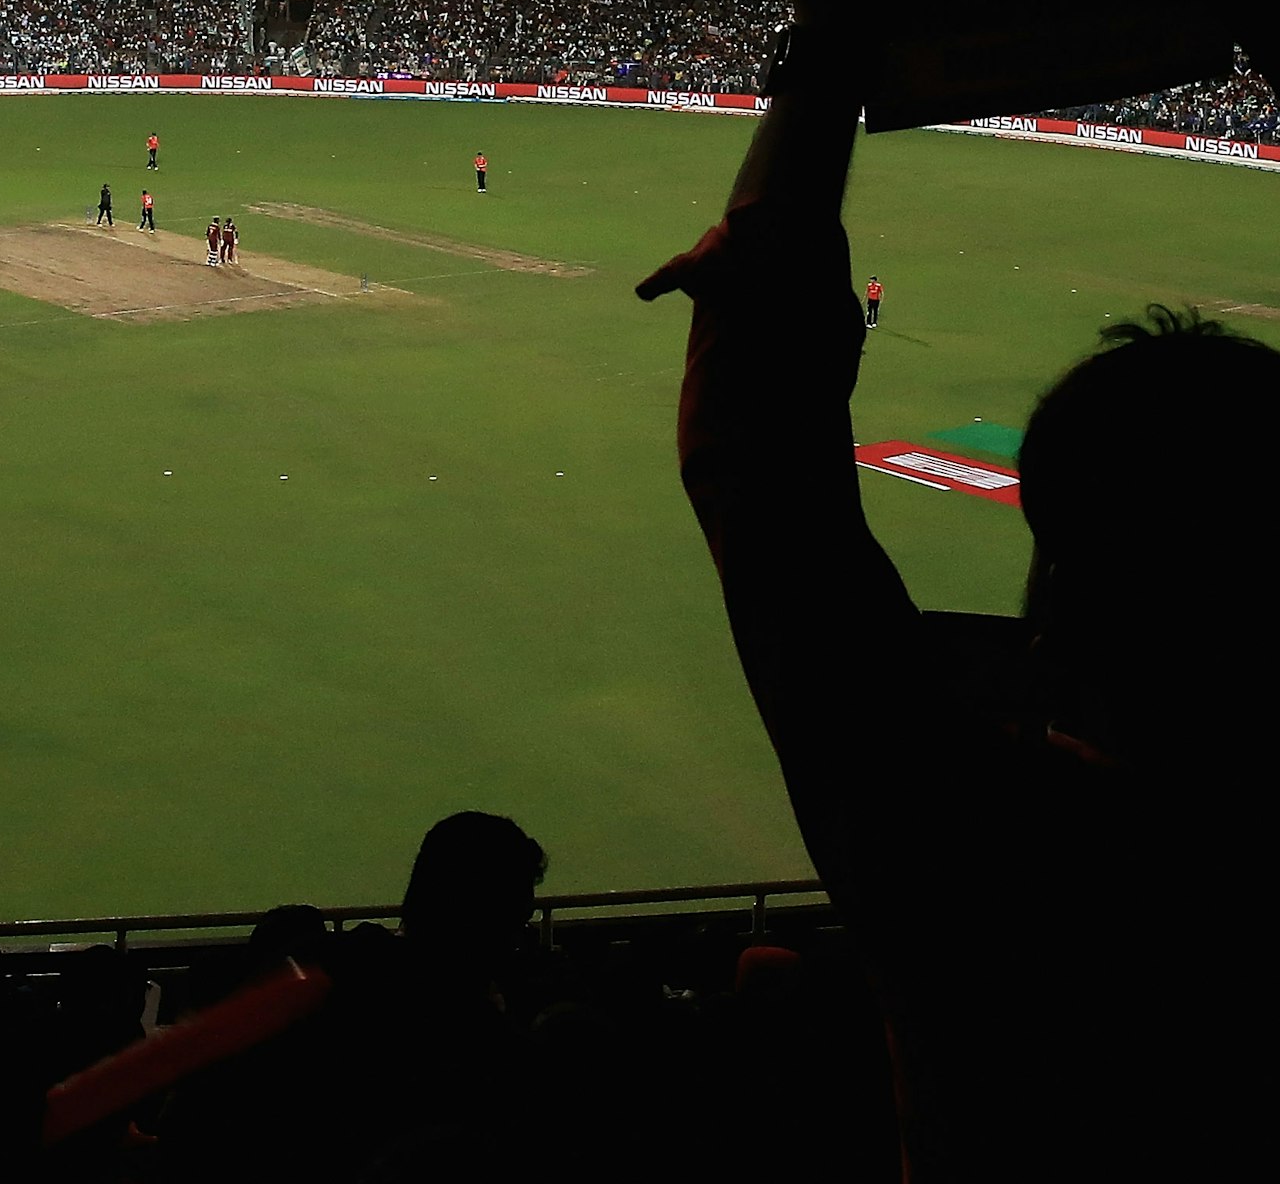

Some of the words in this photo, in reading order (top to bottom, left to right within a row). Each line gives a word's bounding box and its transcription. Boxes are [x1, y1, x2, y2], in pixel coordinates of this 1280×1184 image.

[87, 76, 159, 89] NISSAN
[201, 76, 272, 90] NISSAN
[313, 78, 384, 93] NISSAN
[425, 81, 496, 97] NISSAN
[537, 85, 607, 101] NISSAN
[648, 90, 715, 107] NISSAN
[1076, 122, 1142, 144] NISSAN
[1185, 136, 1259, 159] NISSAN
